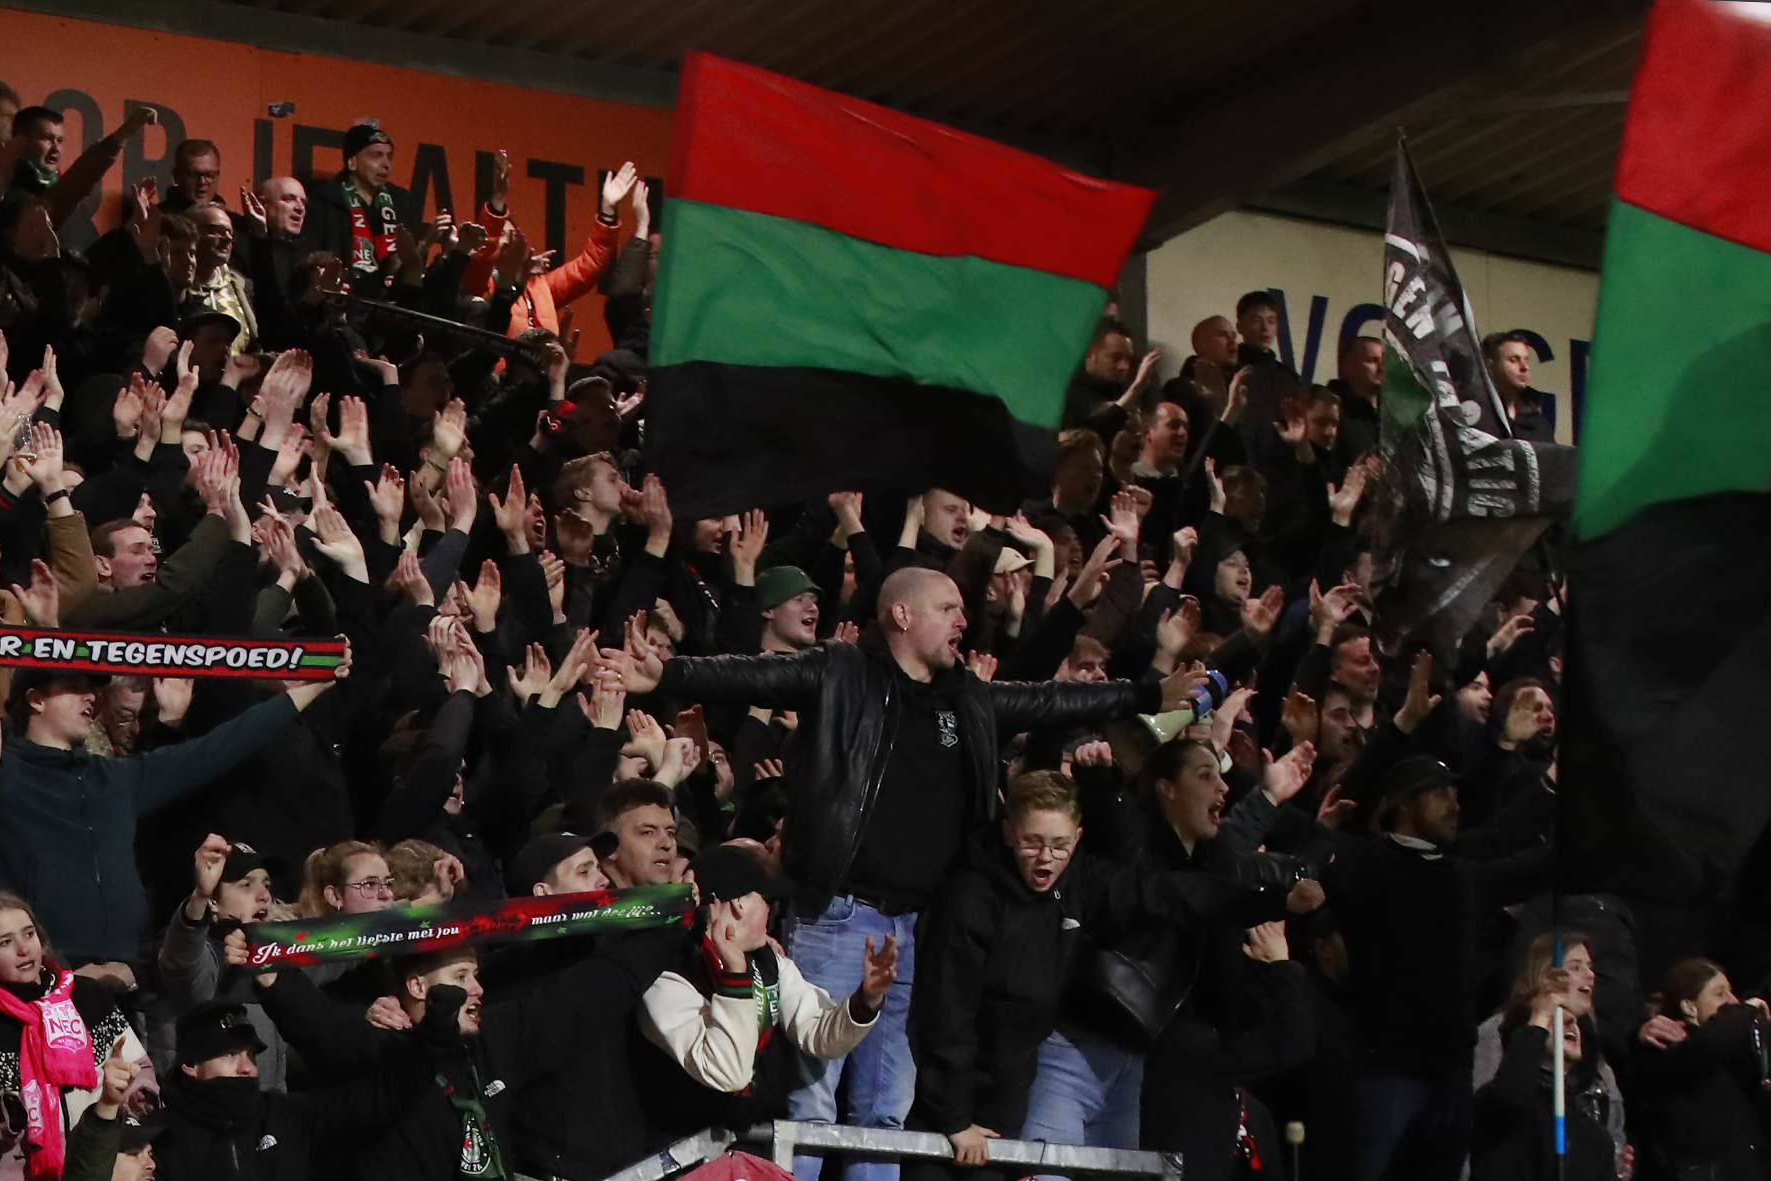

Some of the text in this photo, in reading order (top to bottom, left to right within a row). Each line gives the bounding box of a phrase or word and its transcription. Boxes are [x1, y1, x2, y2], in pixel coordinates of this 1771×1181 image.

[33, 637, 76, 660] EN
[85, 640, 305, 670] TEGENSPOED!
[531, 913, 568, 926] maar
[571, 909, 600, 921] wat
[285, 942, 325, 955] dans
[329, 936, 353, 950] het
[355, 931, 405, 947] liefste
[407, 926, 435, 941] met
[435, 926, 460, 940] jou
[49, 1018, 82, 1035] NEC
